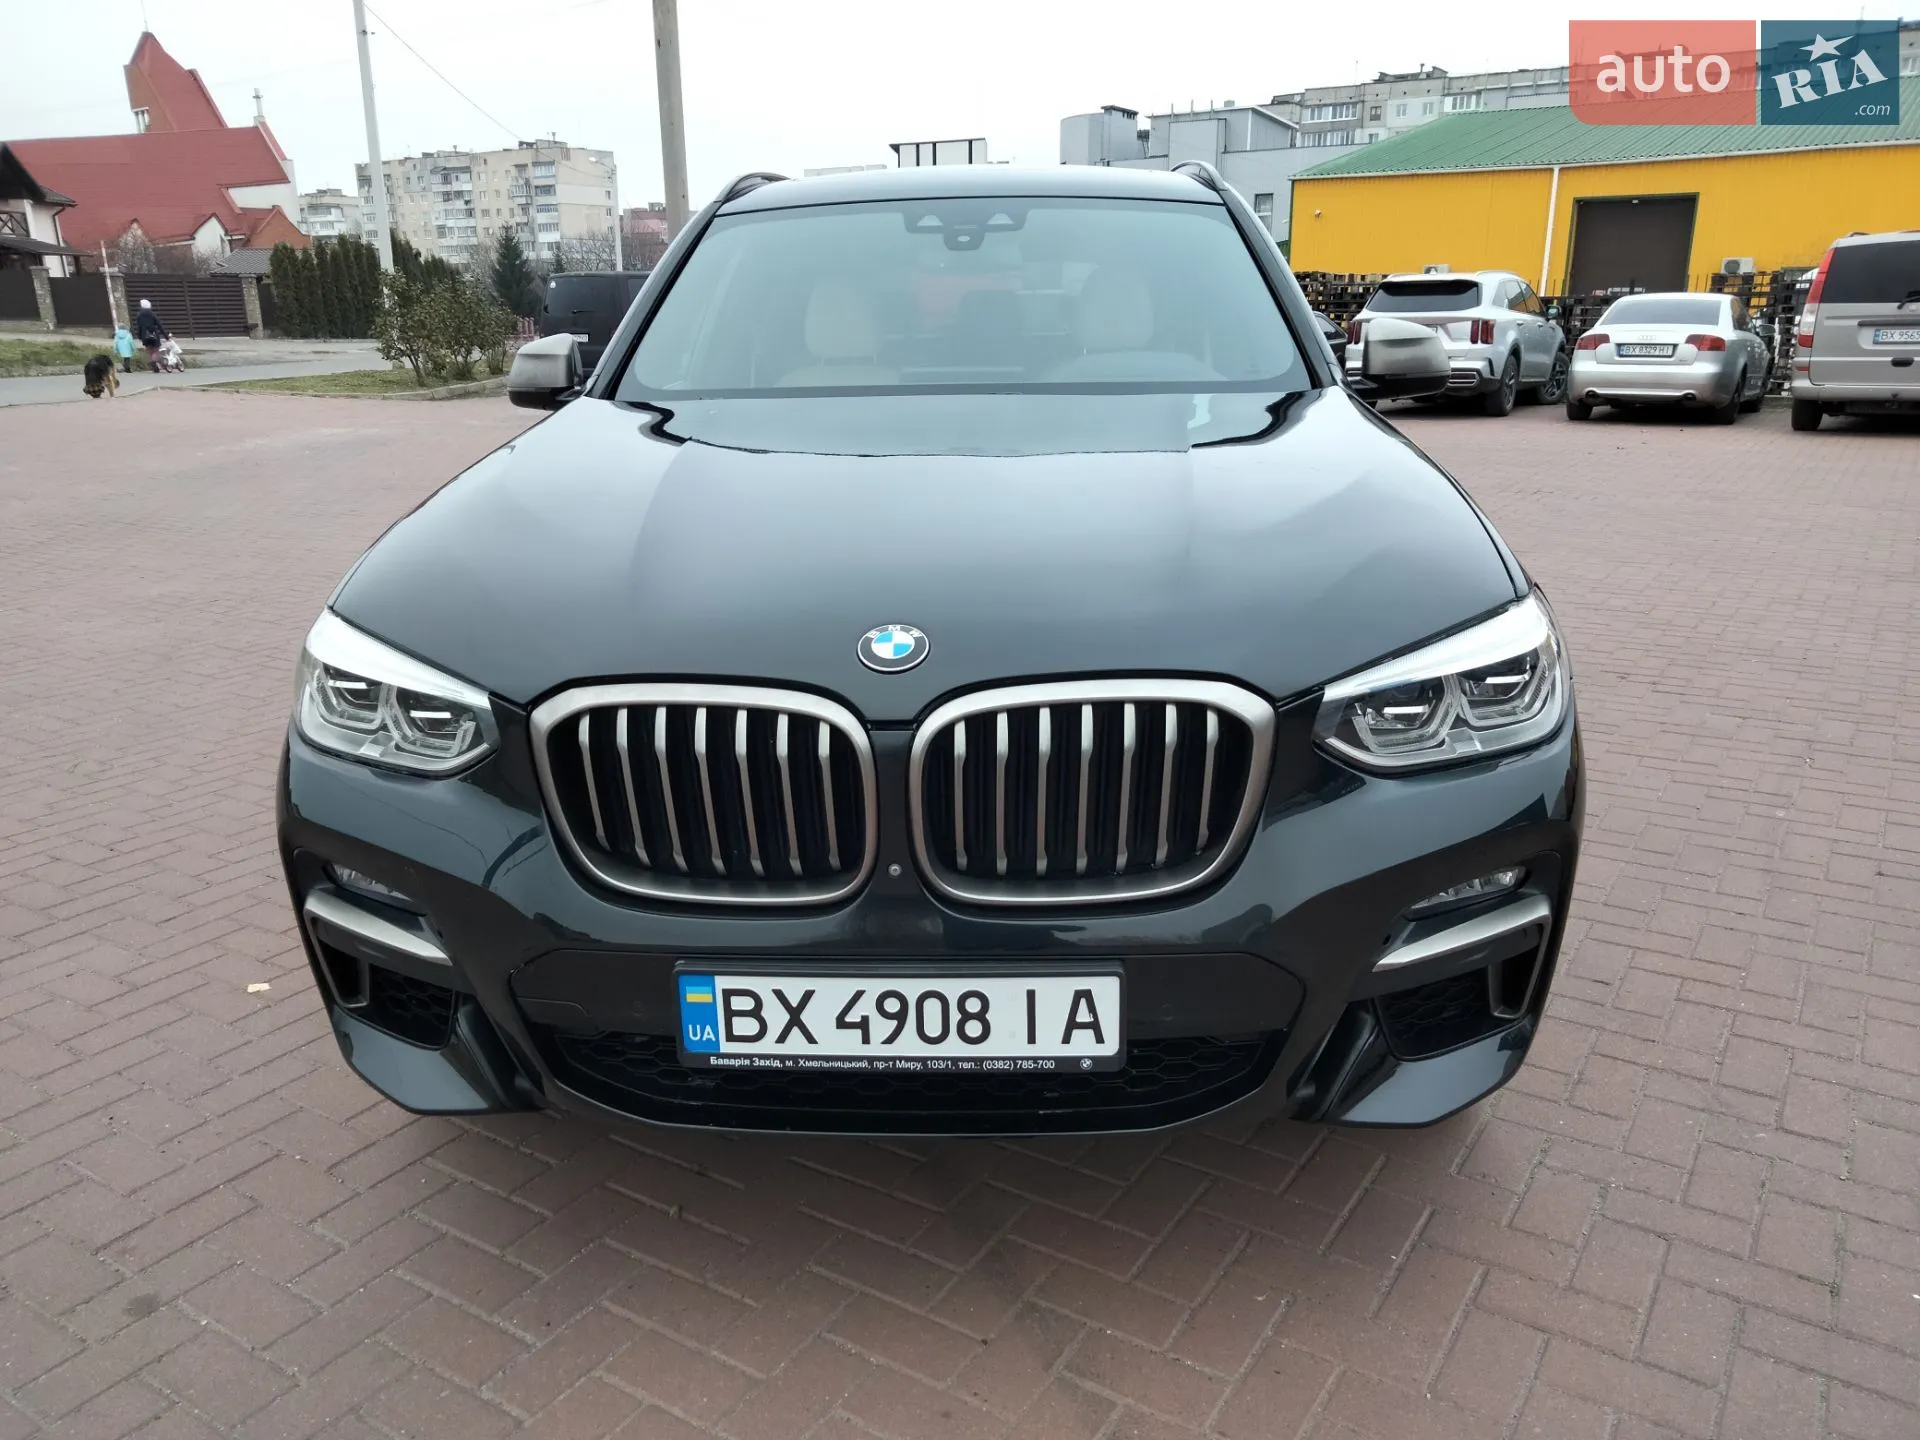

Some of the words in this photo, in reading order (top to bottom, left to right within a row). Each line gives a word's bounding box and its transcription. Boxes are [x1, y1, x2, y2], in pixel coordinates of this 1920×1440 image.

[1881, 330, 1896, 340] BX
[866, 624, 924, 638] BMW
[721, 988, 818, 1044] BX
[835, 988, 992, 1045] 4908
[688, 1024, 716, 1042] UA
[710, 1056, 750, 1067] Баварія
[752, 1057, 783, 1068] Захід,
[798, 1058, 871, 1069] Хмельницький,
[873, 1061, 893, 1070] пр-т
[896, 1060, 923, 1070] Миру,
[926, 1060, 955, 1070] 103/1,
[957, 1061, 980, 1069] тел.:
[982, 1059, 1014, 1070] (0382)
[1016, 1060, 1055, 1069] 785-700
